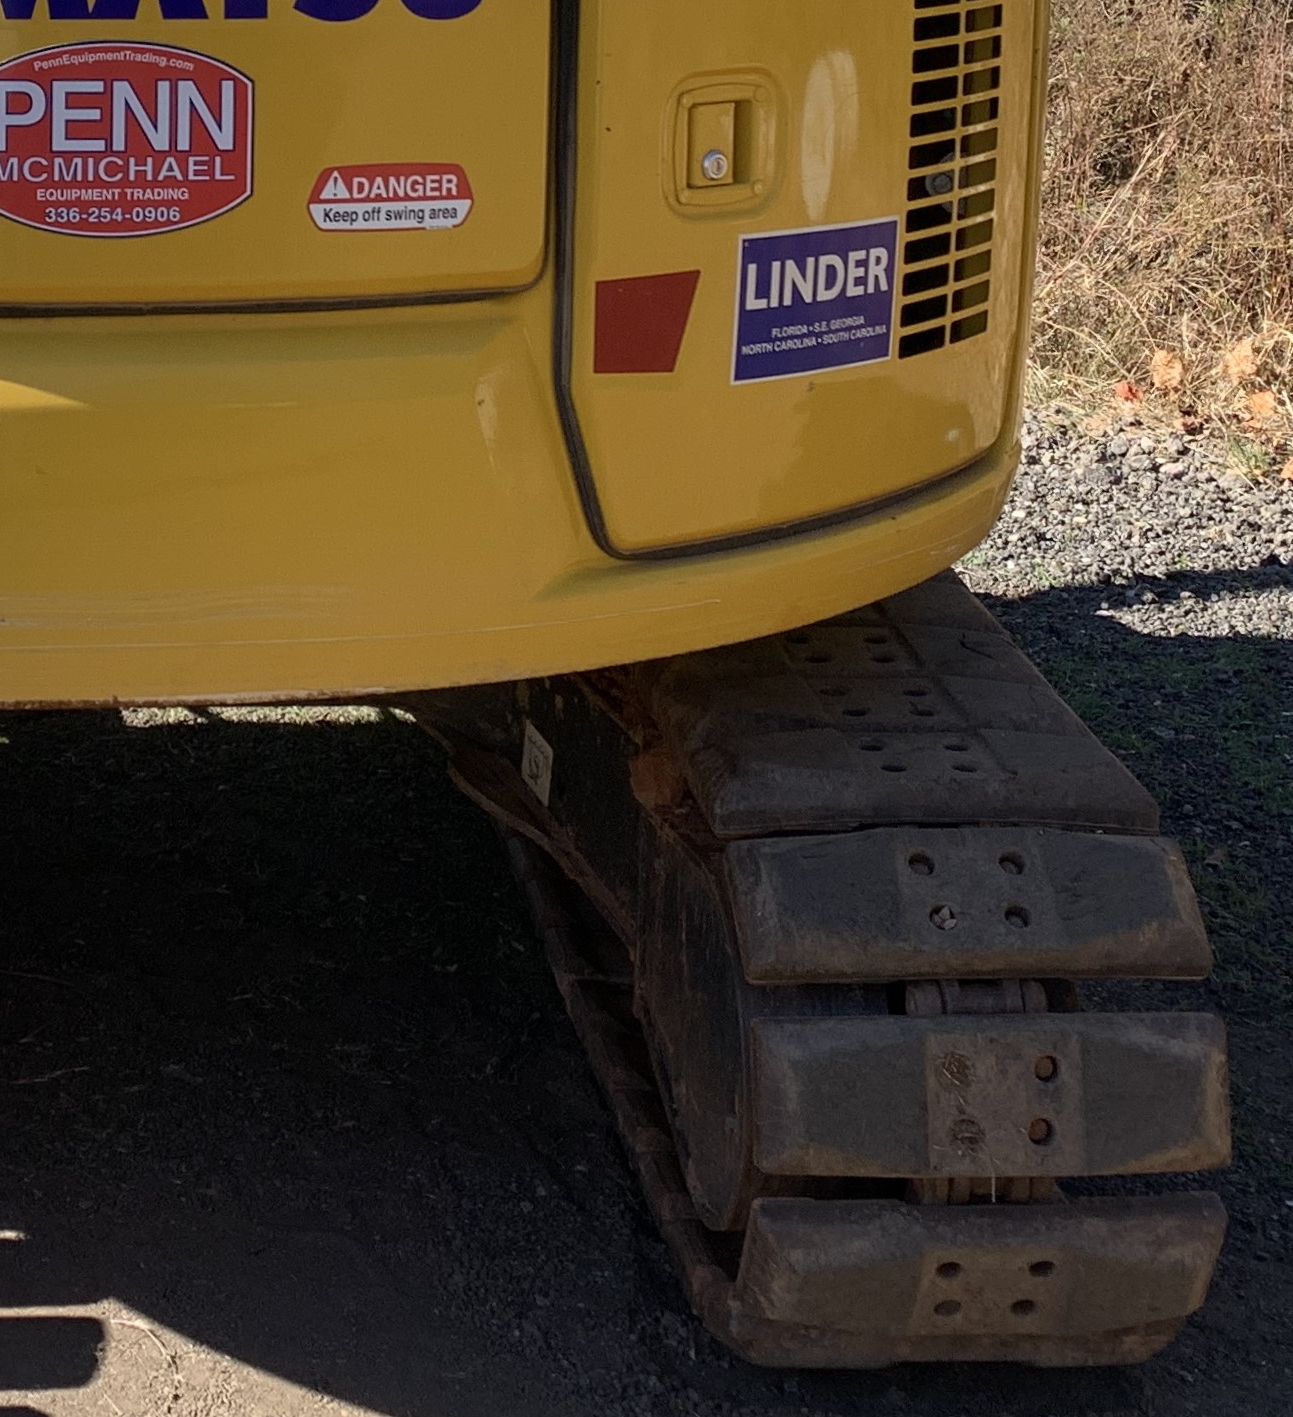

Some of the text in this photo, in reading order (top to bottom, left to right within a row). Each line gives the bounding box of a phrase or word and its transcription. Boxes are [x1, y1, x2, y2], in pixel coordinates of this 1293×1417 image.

[33, 50, 195, 72] PennEquipmentTrading.com
[36, 188, 190, 201] EQUIPMENT TRADING
[352, 174, 458, 199] DANGER
[45, 206, 181, 224] 336-254-0906
[323, 205, 458, 226] Keep off swing area
[745, 246, 889, 311] LINDER
[771, 324, 808, 338] FLORIDA
[830, 315, 865, 330] GEORGIA
[741, 324, 887, 355] NORTH CAROLINA SOUTH CAROLINA
